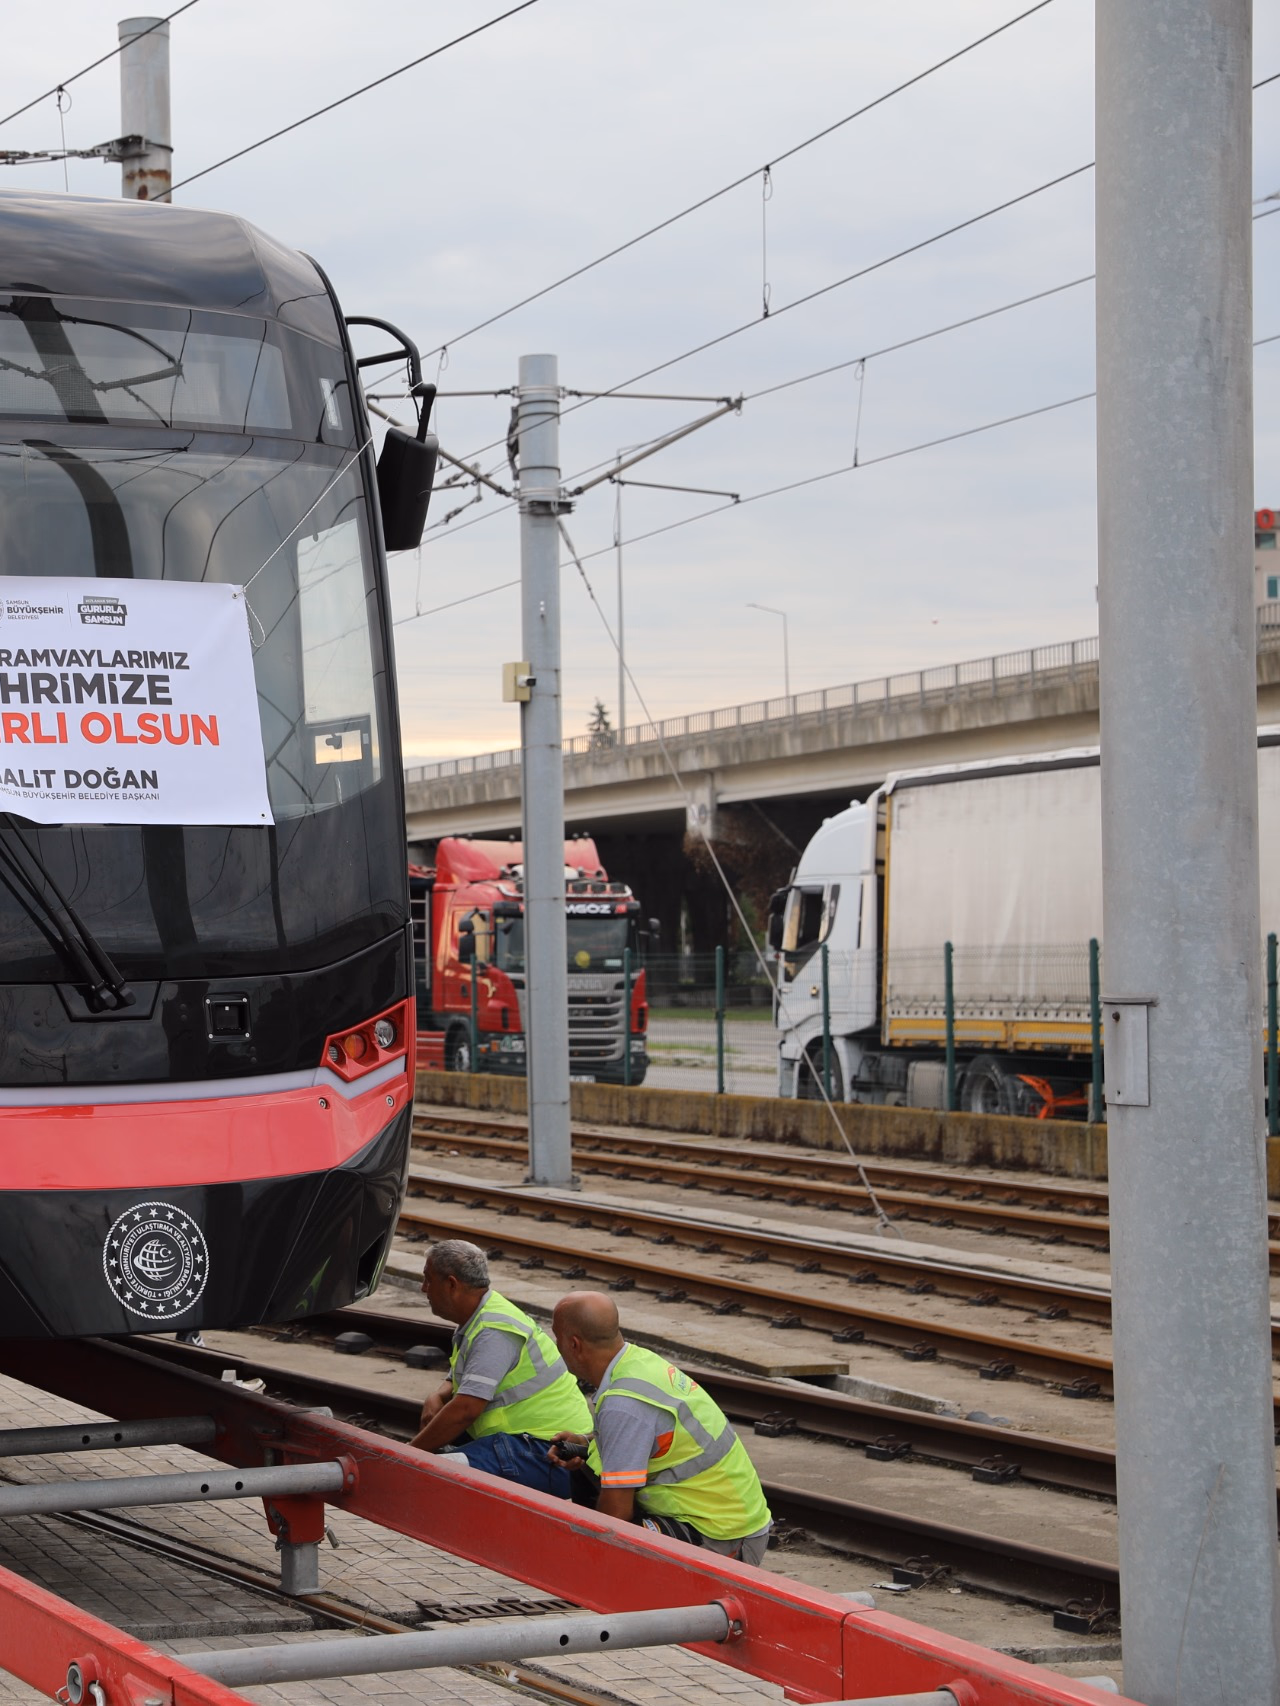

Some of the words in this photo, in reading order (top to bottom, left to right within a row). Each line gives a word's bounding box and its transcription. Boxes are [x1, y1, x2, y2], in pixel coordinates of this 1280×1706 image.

[7, 604, 64, 615] BÜYÜKŞEHİR
[80, 604, 124, 614] GURURLA
[84, 615, 123, 625] SAMSUN
[80, 711, 220, 746] OLSUN
[63, 766, 159, 790] DOĞAN
[23, 790, 76, 801] BÜYÜKŞEHİR
[78, 792, 120, 801] BELEDİYE
[122, 793, 160, 802] BAŞKANI
[568, 979, 603, 990] ANIA
[136, 1222, 173, 1235] ULAŞTIRMA
[174, 1230, 182, 1241] VE
[122, 1231, 139, 1279] CUMHURİYETİ
[179, 1239, 191, 1269] ALTYAPI
[130, 1278, 157, 1298] TÜRKİYE
